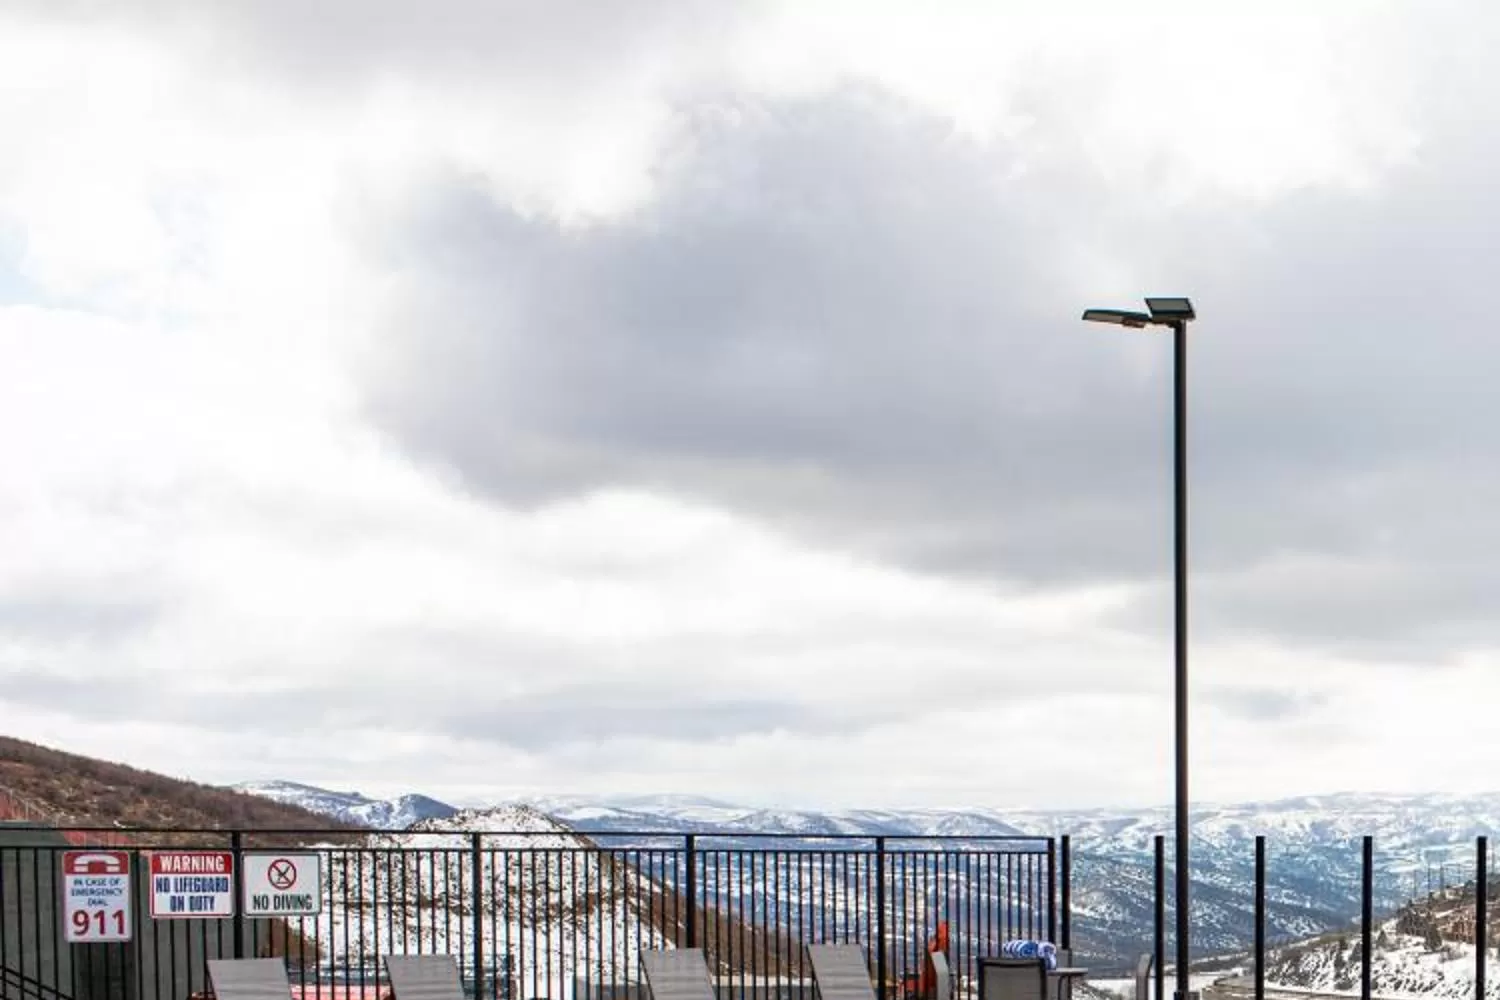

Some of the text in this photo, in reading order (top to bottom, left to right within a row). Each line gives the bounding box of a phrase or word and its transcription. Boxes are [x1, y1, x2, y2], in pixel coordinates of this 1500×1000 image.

[159, 855, 225, 873] WARNING
[71, 887, 123, 897] EMERGENCY
[155, 877, 229, 893] NO LIFEGUARD
[169, 895, 215, 912] ON DUTY
[252, 893, 313, 911] NO DIVING
[72, 909, 125, 936] 911
